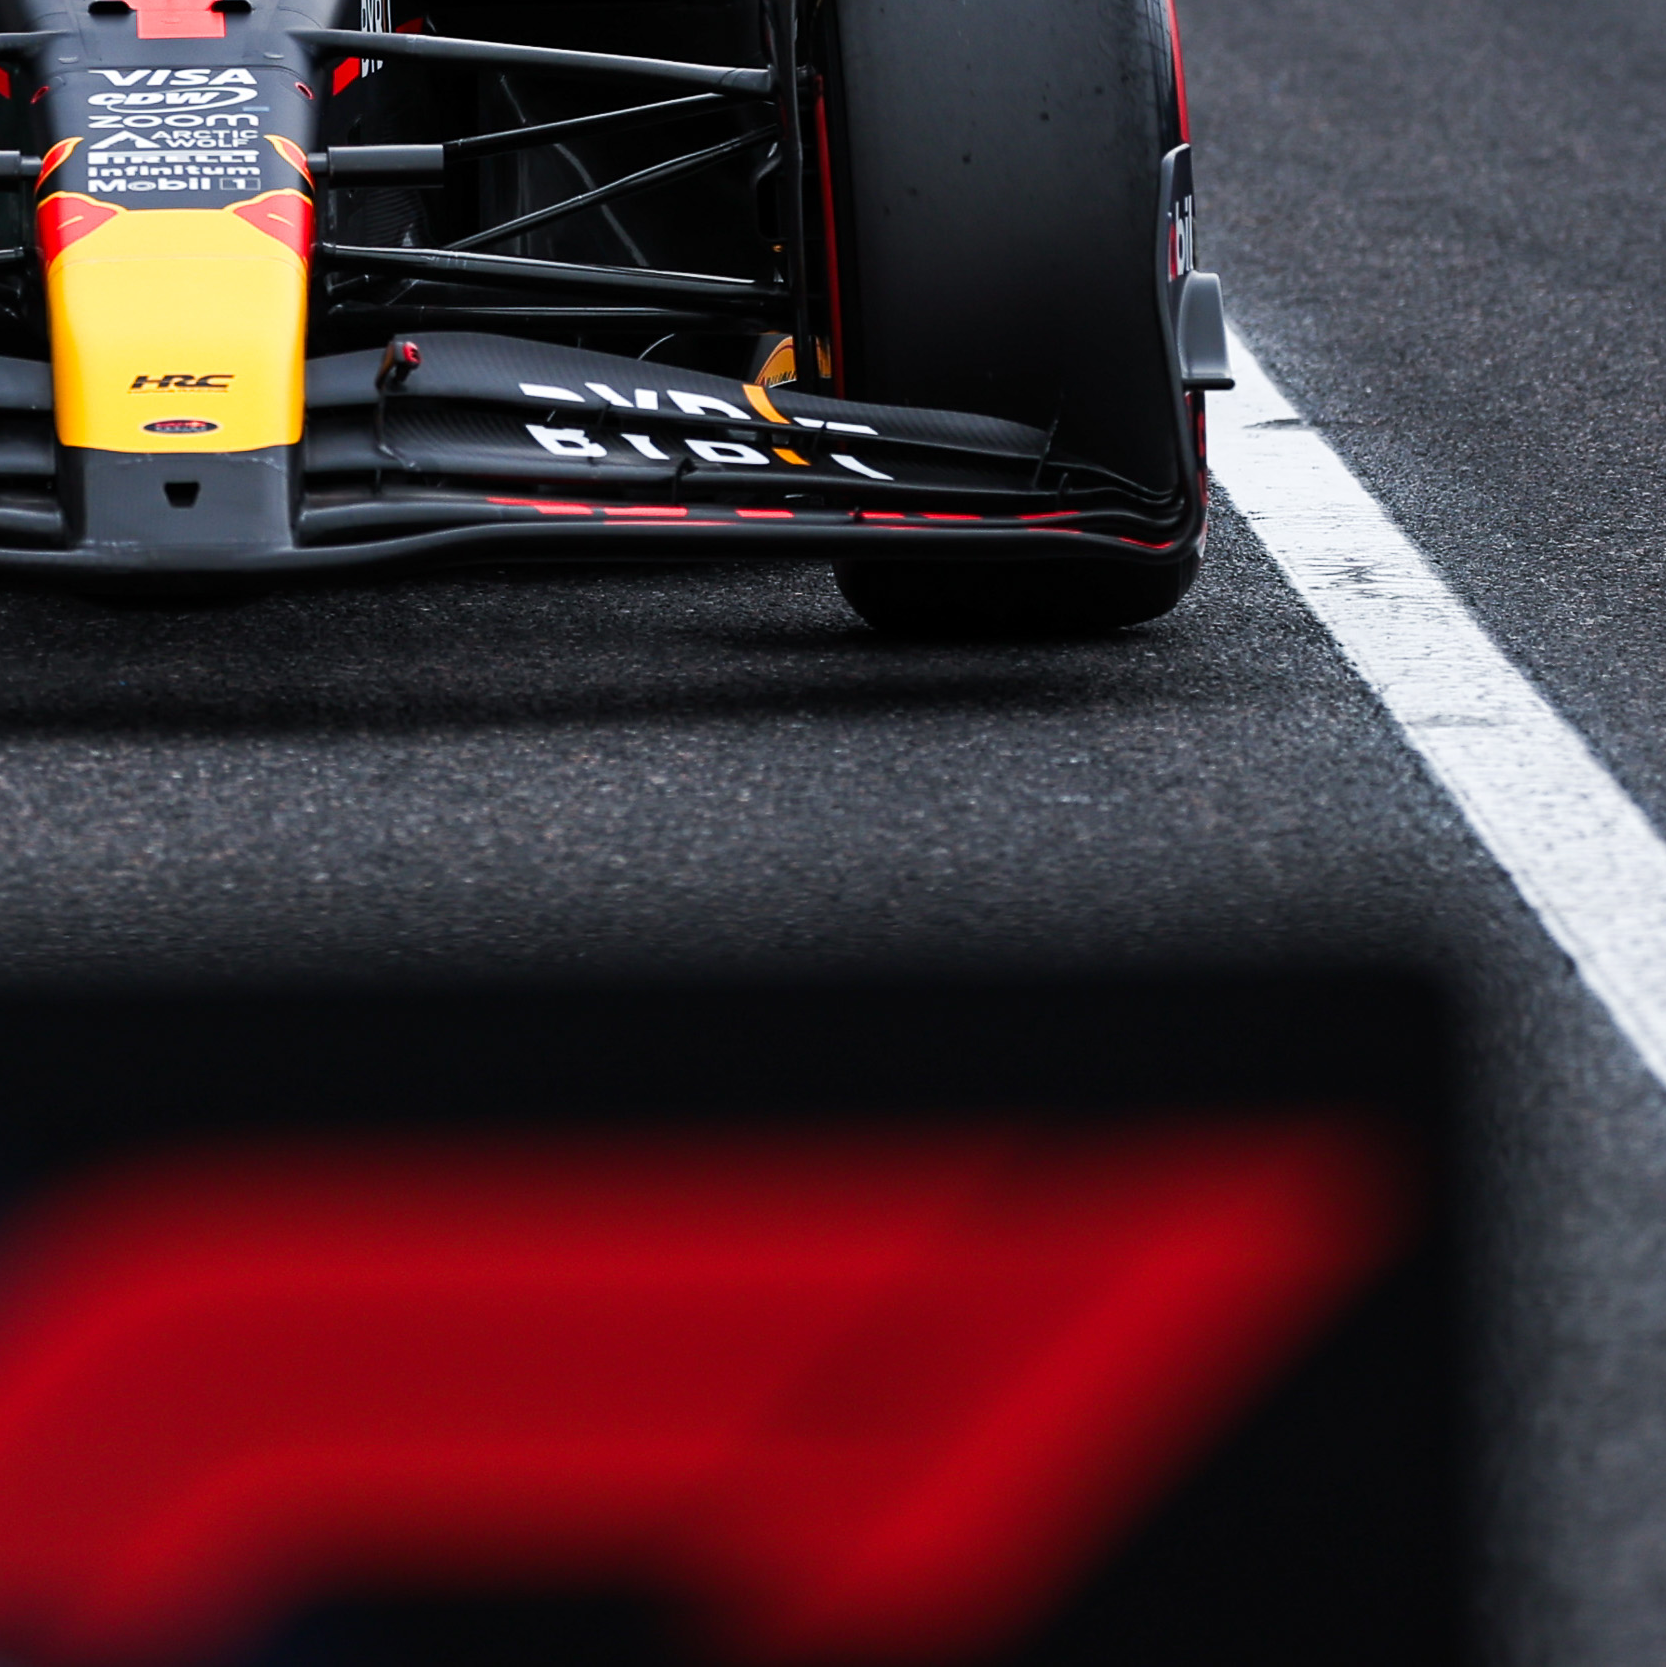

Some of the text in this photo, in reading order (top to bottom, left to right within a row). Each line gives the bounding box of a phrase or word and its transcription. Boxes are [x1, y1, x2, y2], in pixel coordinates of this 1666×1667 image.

[87, 68, 258, 86] VISA
[88, 113, 259, 128] zoom
[151, 130, 259, 140] ARCTIC
[165, 138, 250, 148] WOLF
[87, 149, 260, 165] PIRELLI
[87, 177, 211, 193] Mobil
[130, 374, 235, 389] HRC
